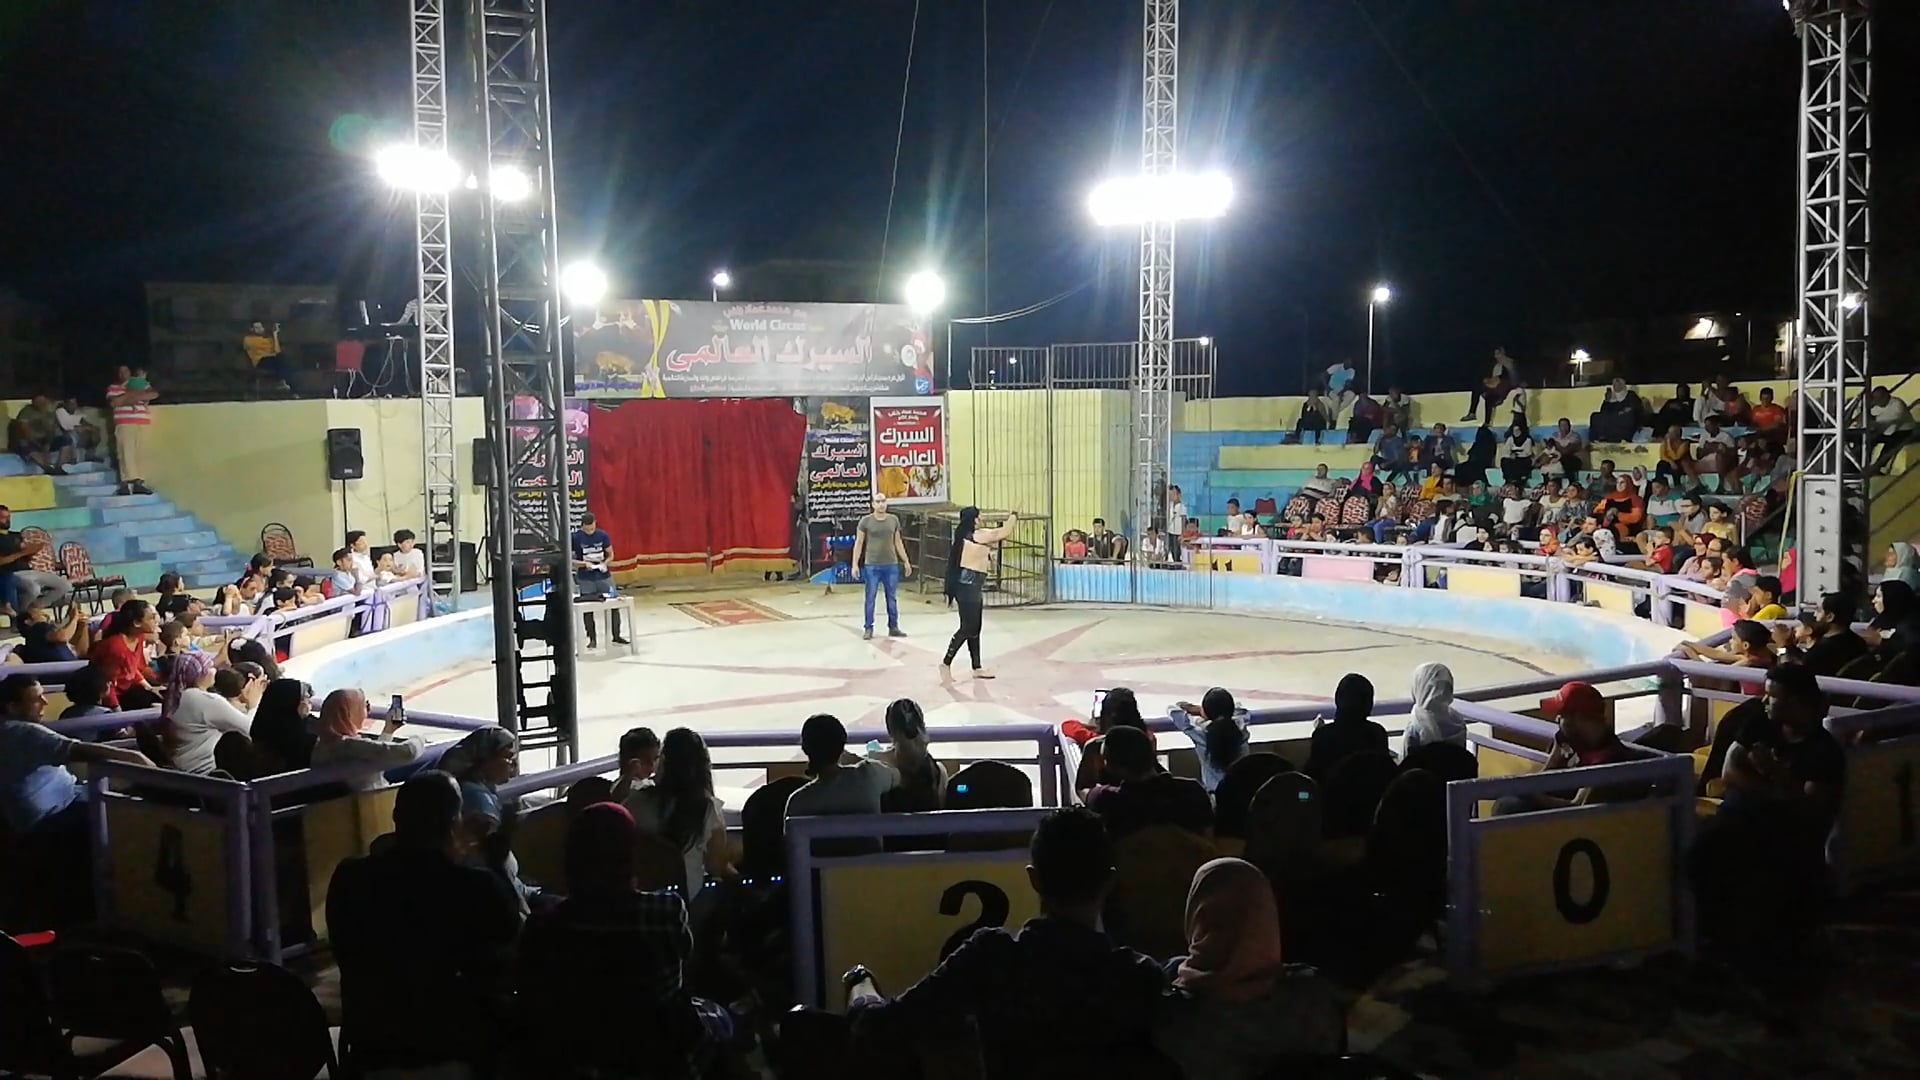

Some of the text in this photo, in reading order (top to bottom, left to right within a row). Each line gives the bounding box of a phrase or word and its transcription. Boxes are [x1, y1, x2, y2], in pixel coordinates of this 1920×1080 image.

[730, 319, 806, 331] World Circus
[775, 335, 874, 372] السيرك
[879, 426, 934, 448] السيرك
[811, 443, 868, 462] السيرك
[1553, 837, 1610, 925] 0
